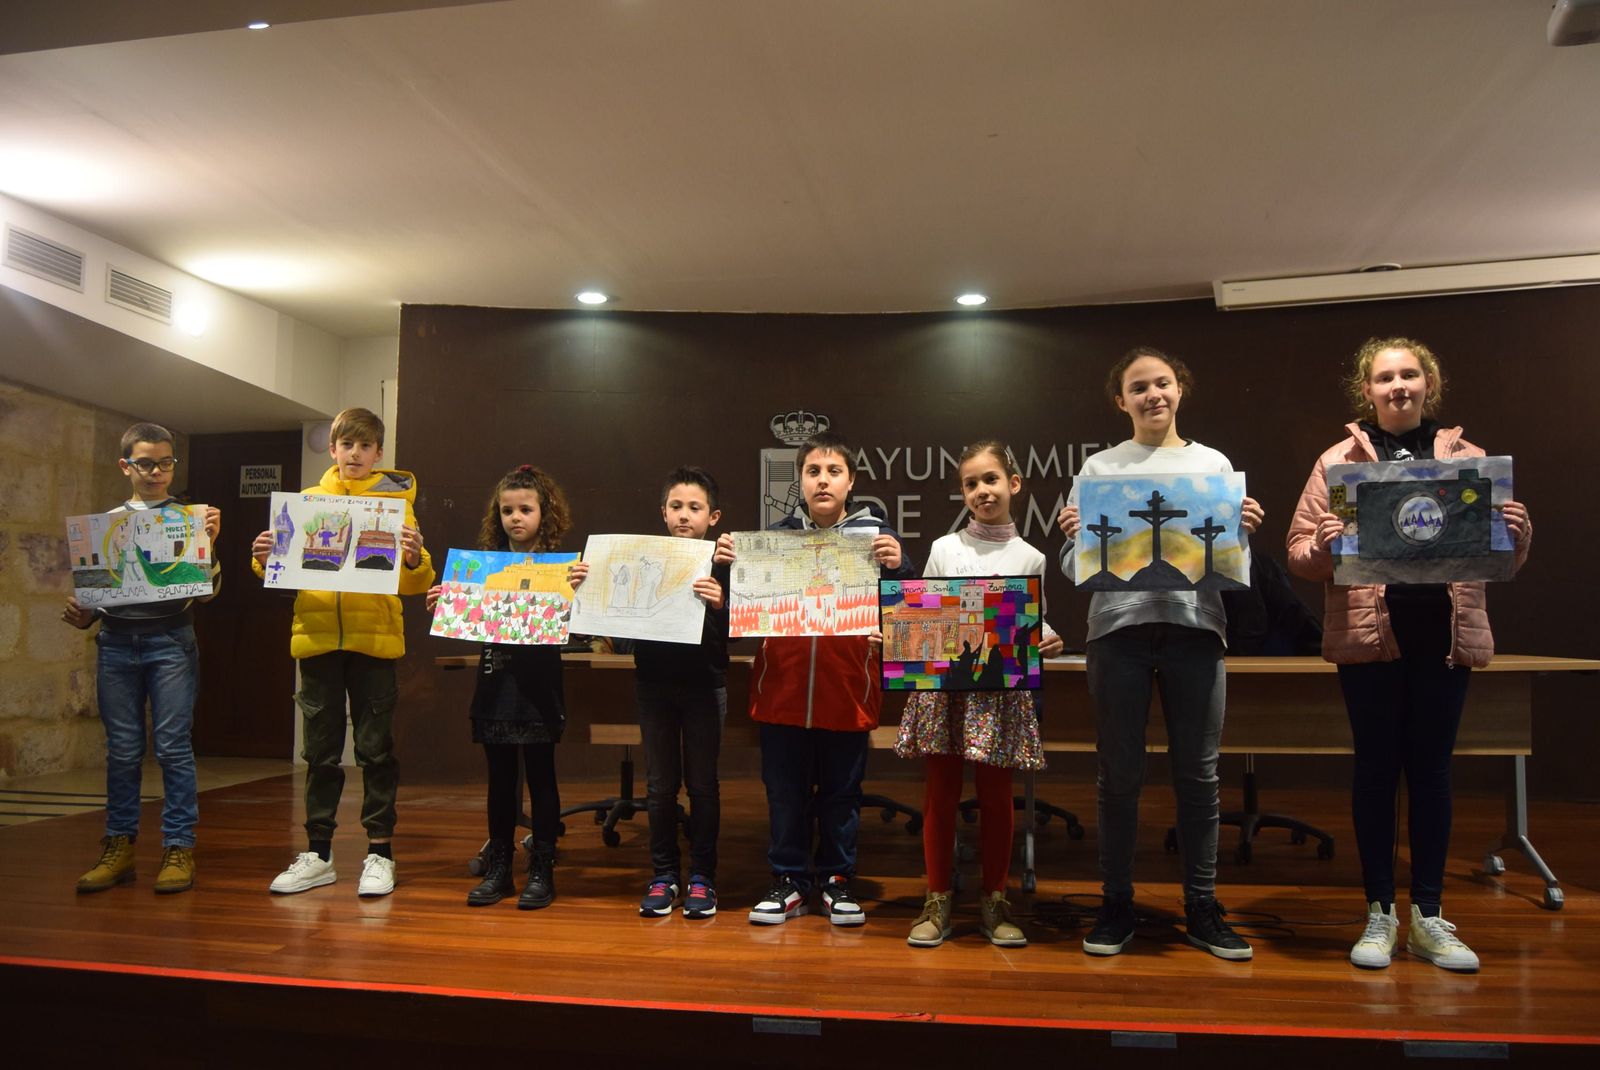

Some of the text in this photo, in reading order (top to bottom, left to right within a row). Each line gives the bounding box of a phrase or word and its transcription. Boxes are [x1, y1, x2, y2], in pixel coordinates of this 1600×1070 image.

[245, 467, 276, 480] PERSONAL
[241, 483, 280, 495] AUTORIZADO
[157, 583, 203, 599] SANTA
[890, 582, 1024, 595] Semana Santa Zamora
